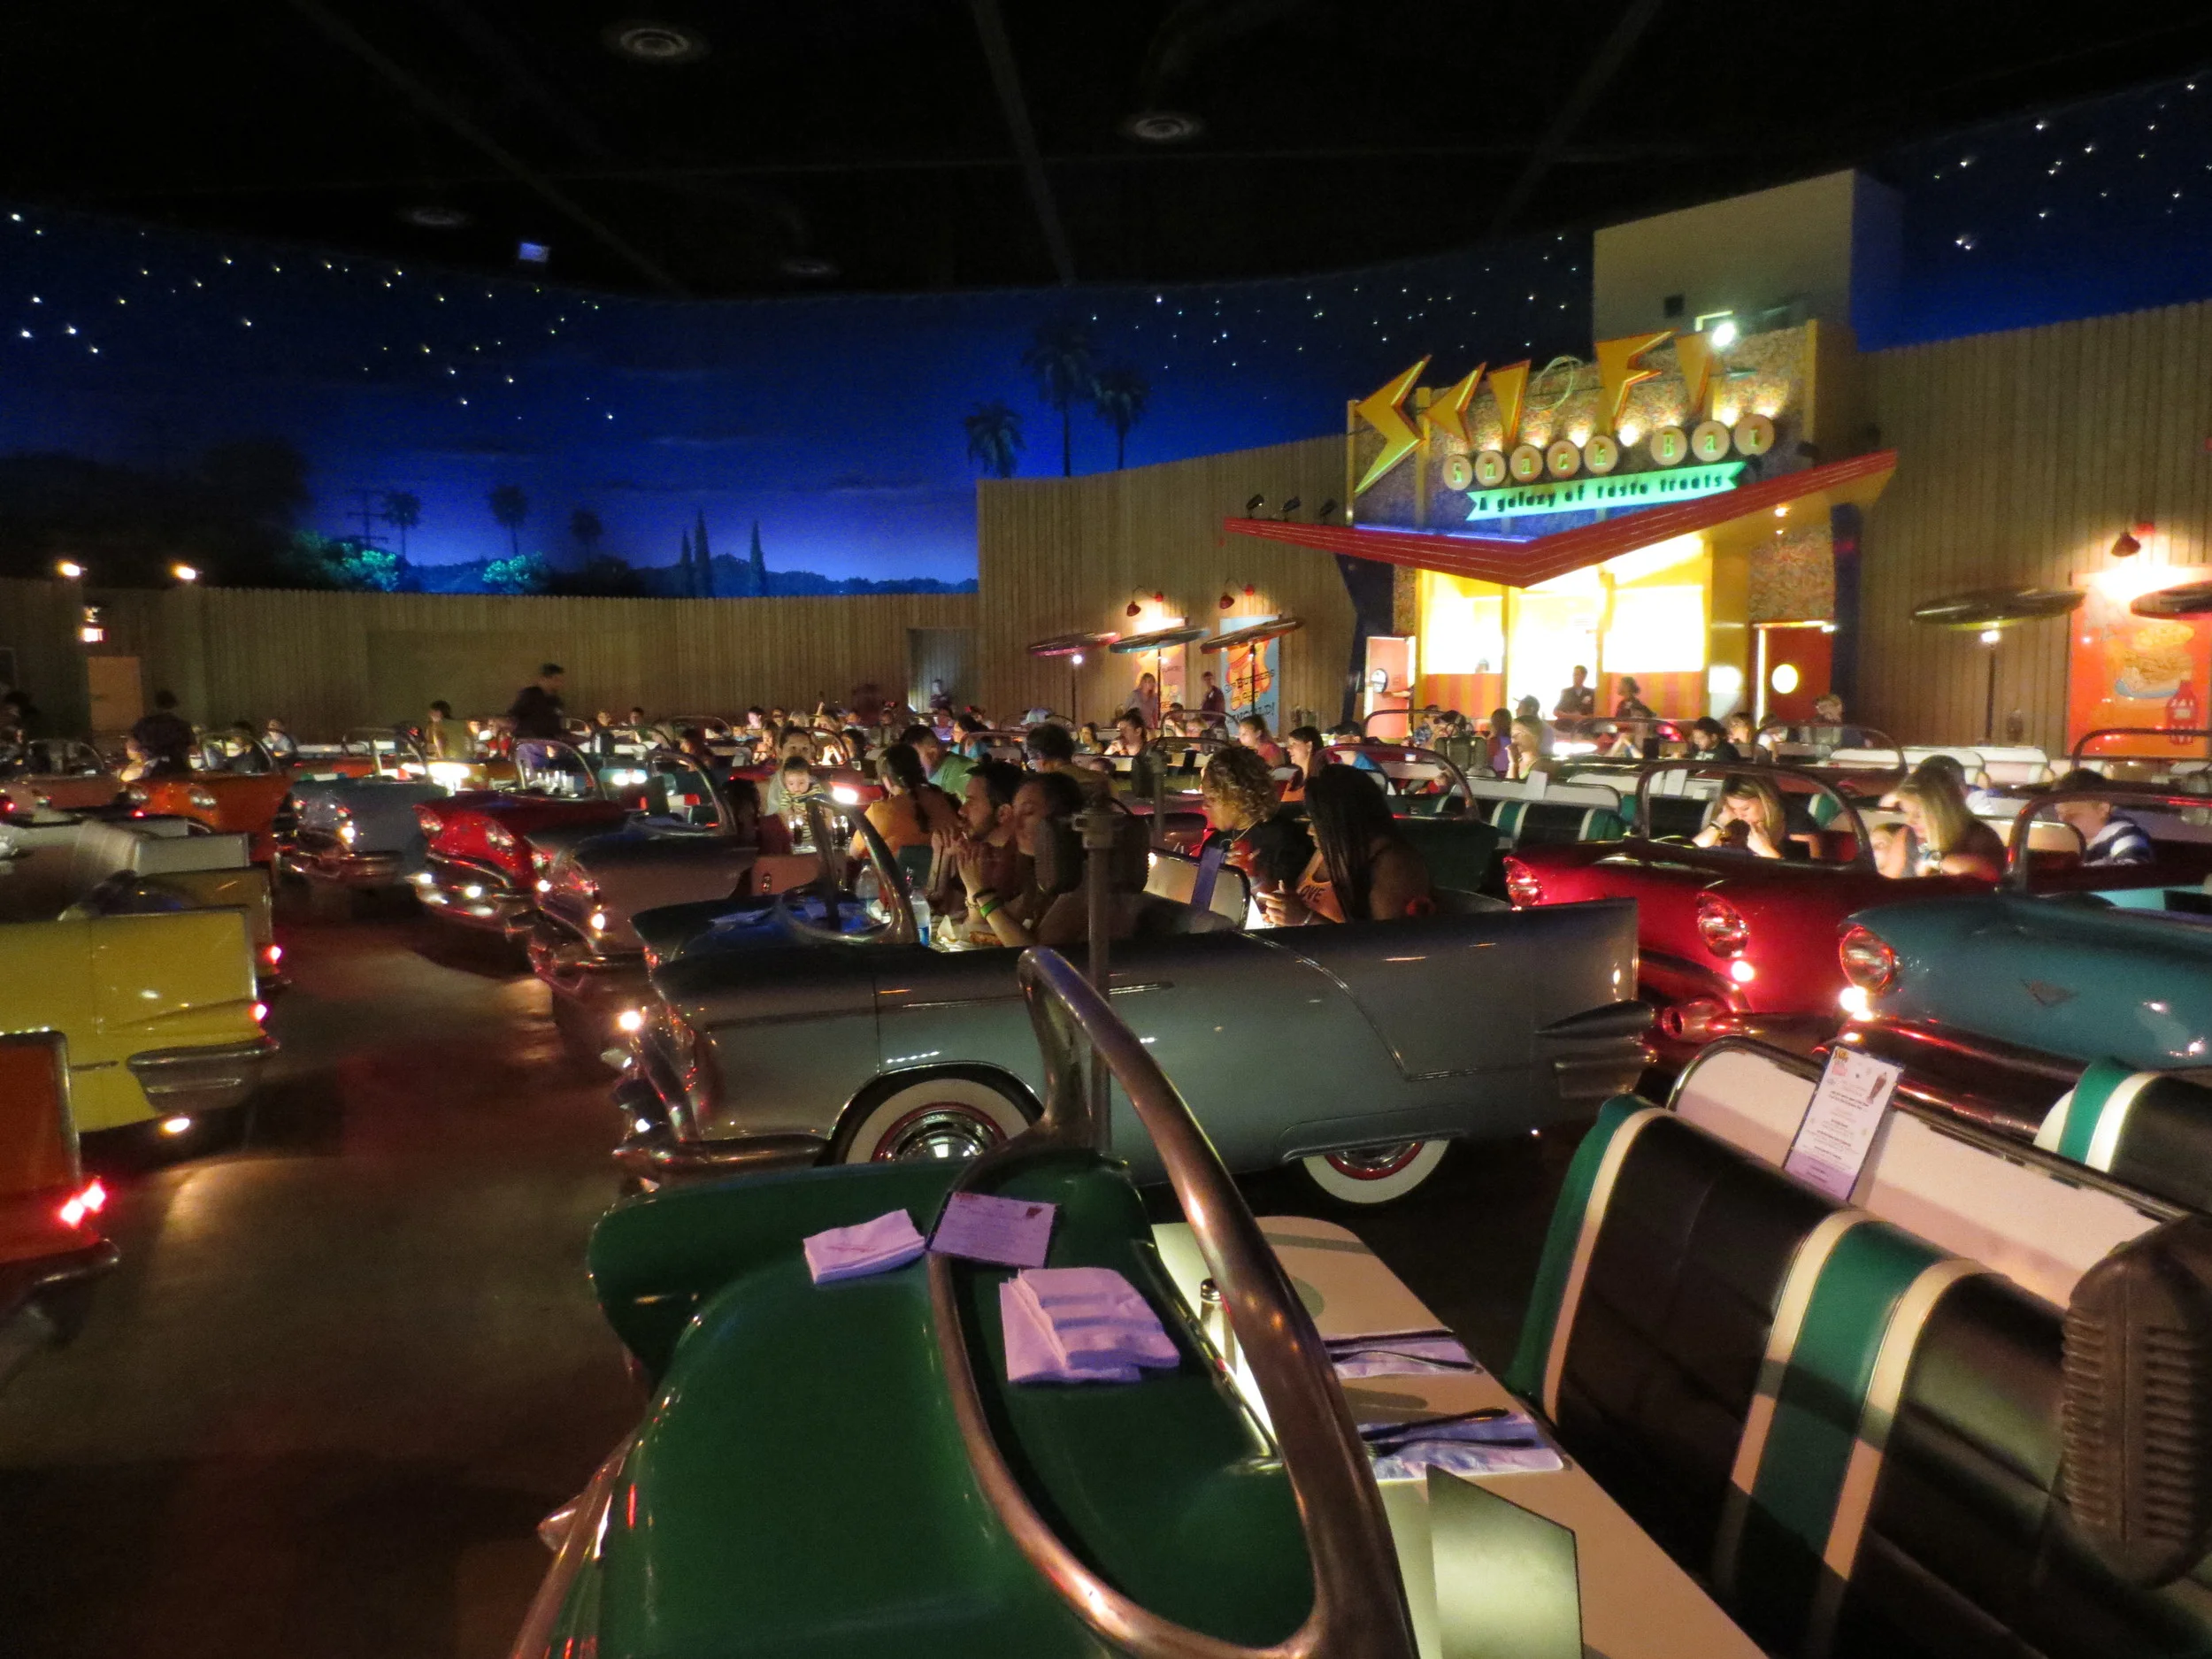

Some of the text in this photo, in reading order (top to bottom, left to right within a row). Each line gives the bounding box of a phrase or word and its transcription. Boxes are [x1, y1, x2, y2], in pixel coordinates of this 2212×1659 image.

[1450, 443, 1609, 486] Snack
[1479, 473, 1724, 513] A galaxy of taste treats
